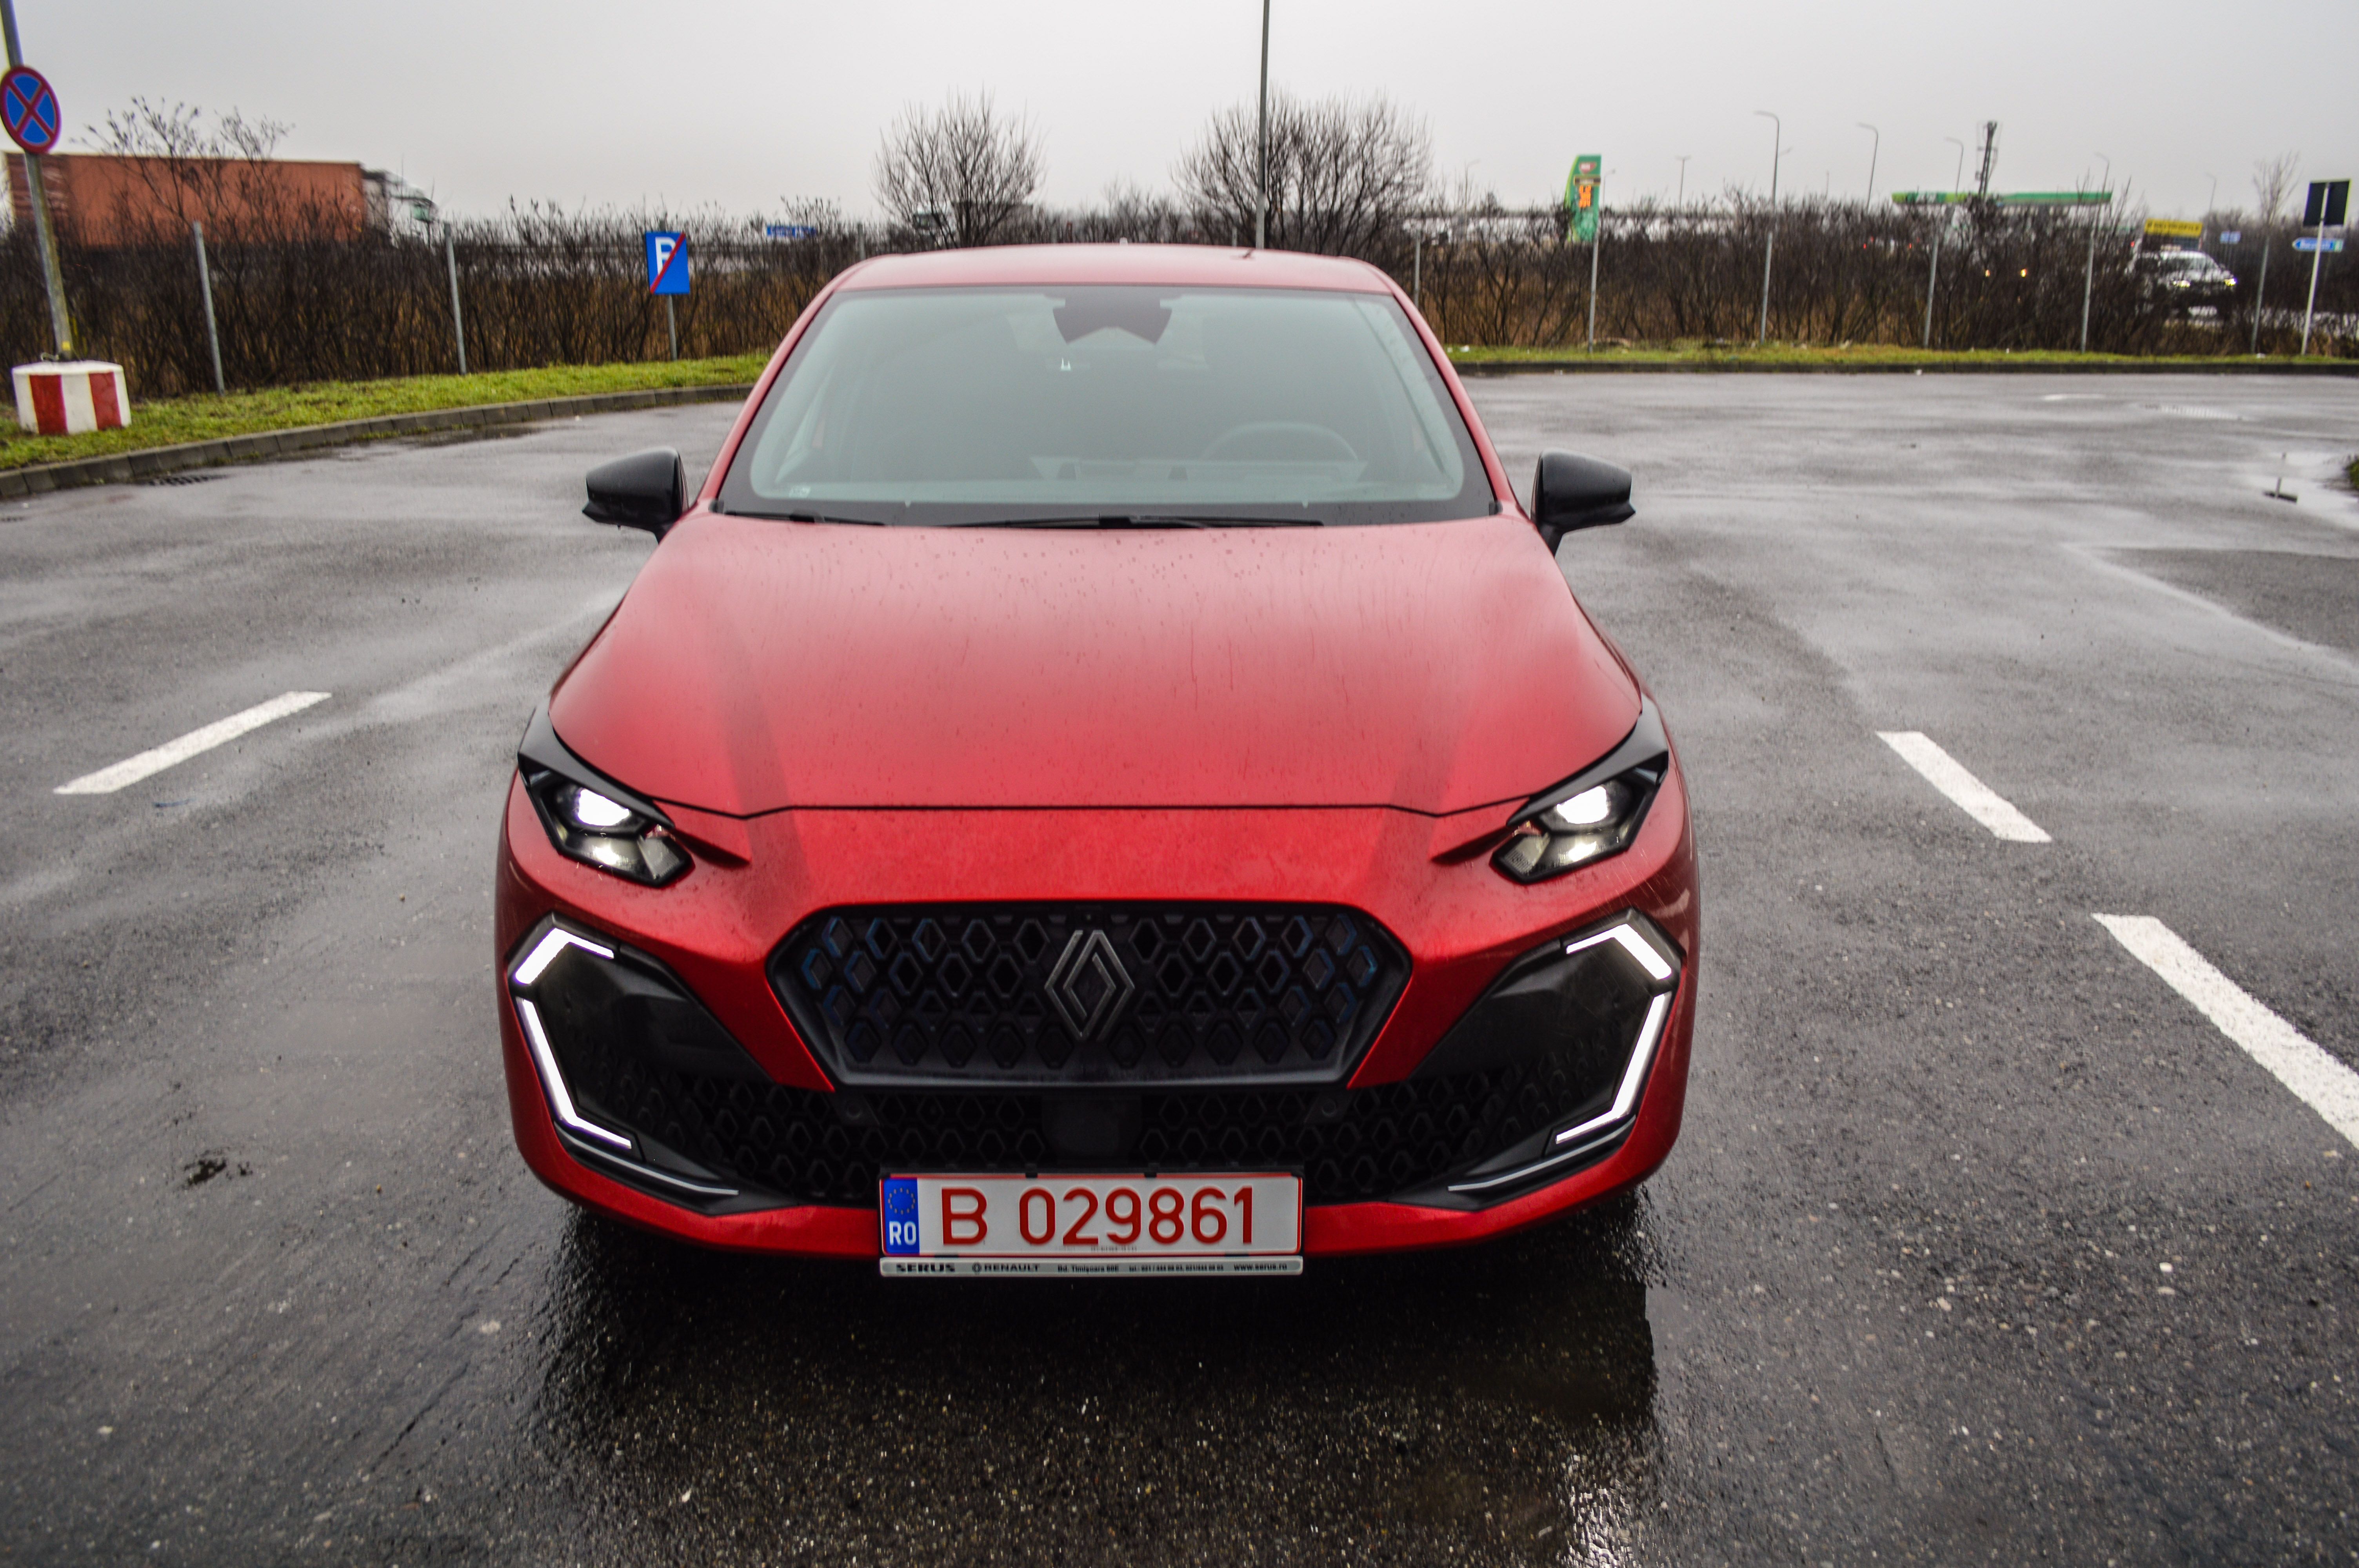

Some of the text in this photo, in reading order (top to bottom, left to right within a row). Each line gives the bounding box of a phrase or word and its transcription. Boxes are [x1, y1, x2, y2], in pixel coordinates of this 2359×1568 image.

[655, 236, 677, 275] P
[941, 1187, 1253, 1245] B 029861
[889, 1221, 916, 1245] RO
[896, 1263, 955, 1272] SERUS
[984, 1263, 1040, 1272] RENAULT
[1234, 1263, 1287, 1272] www.serus.ro
